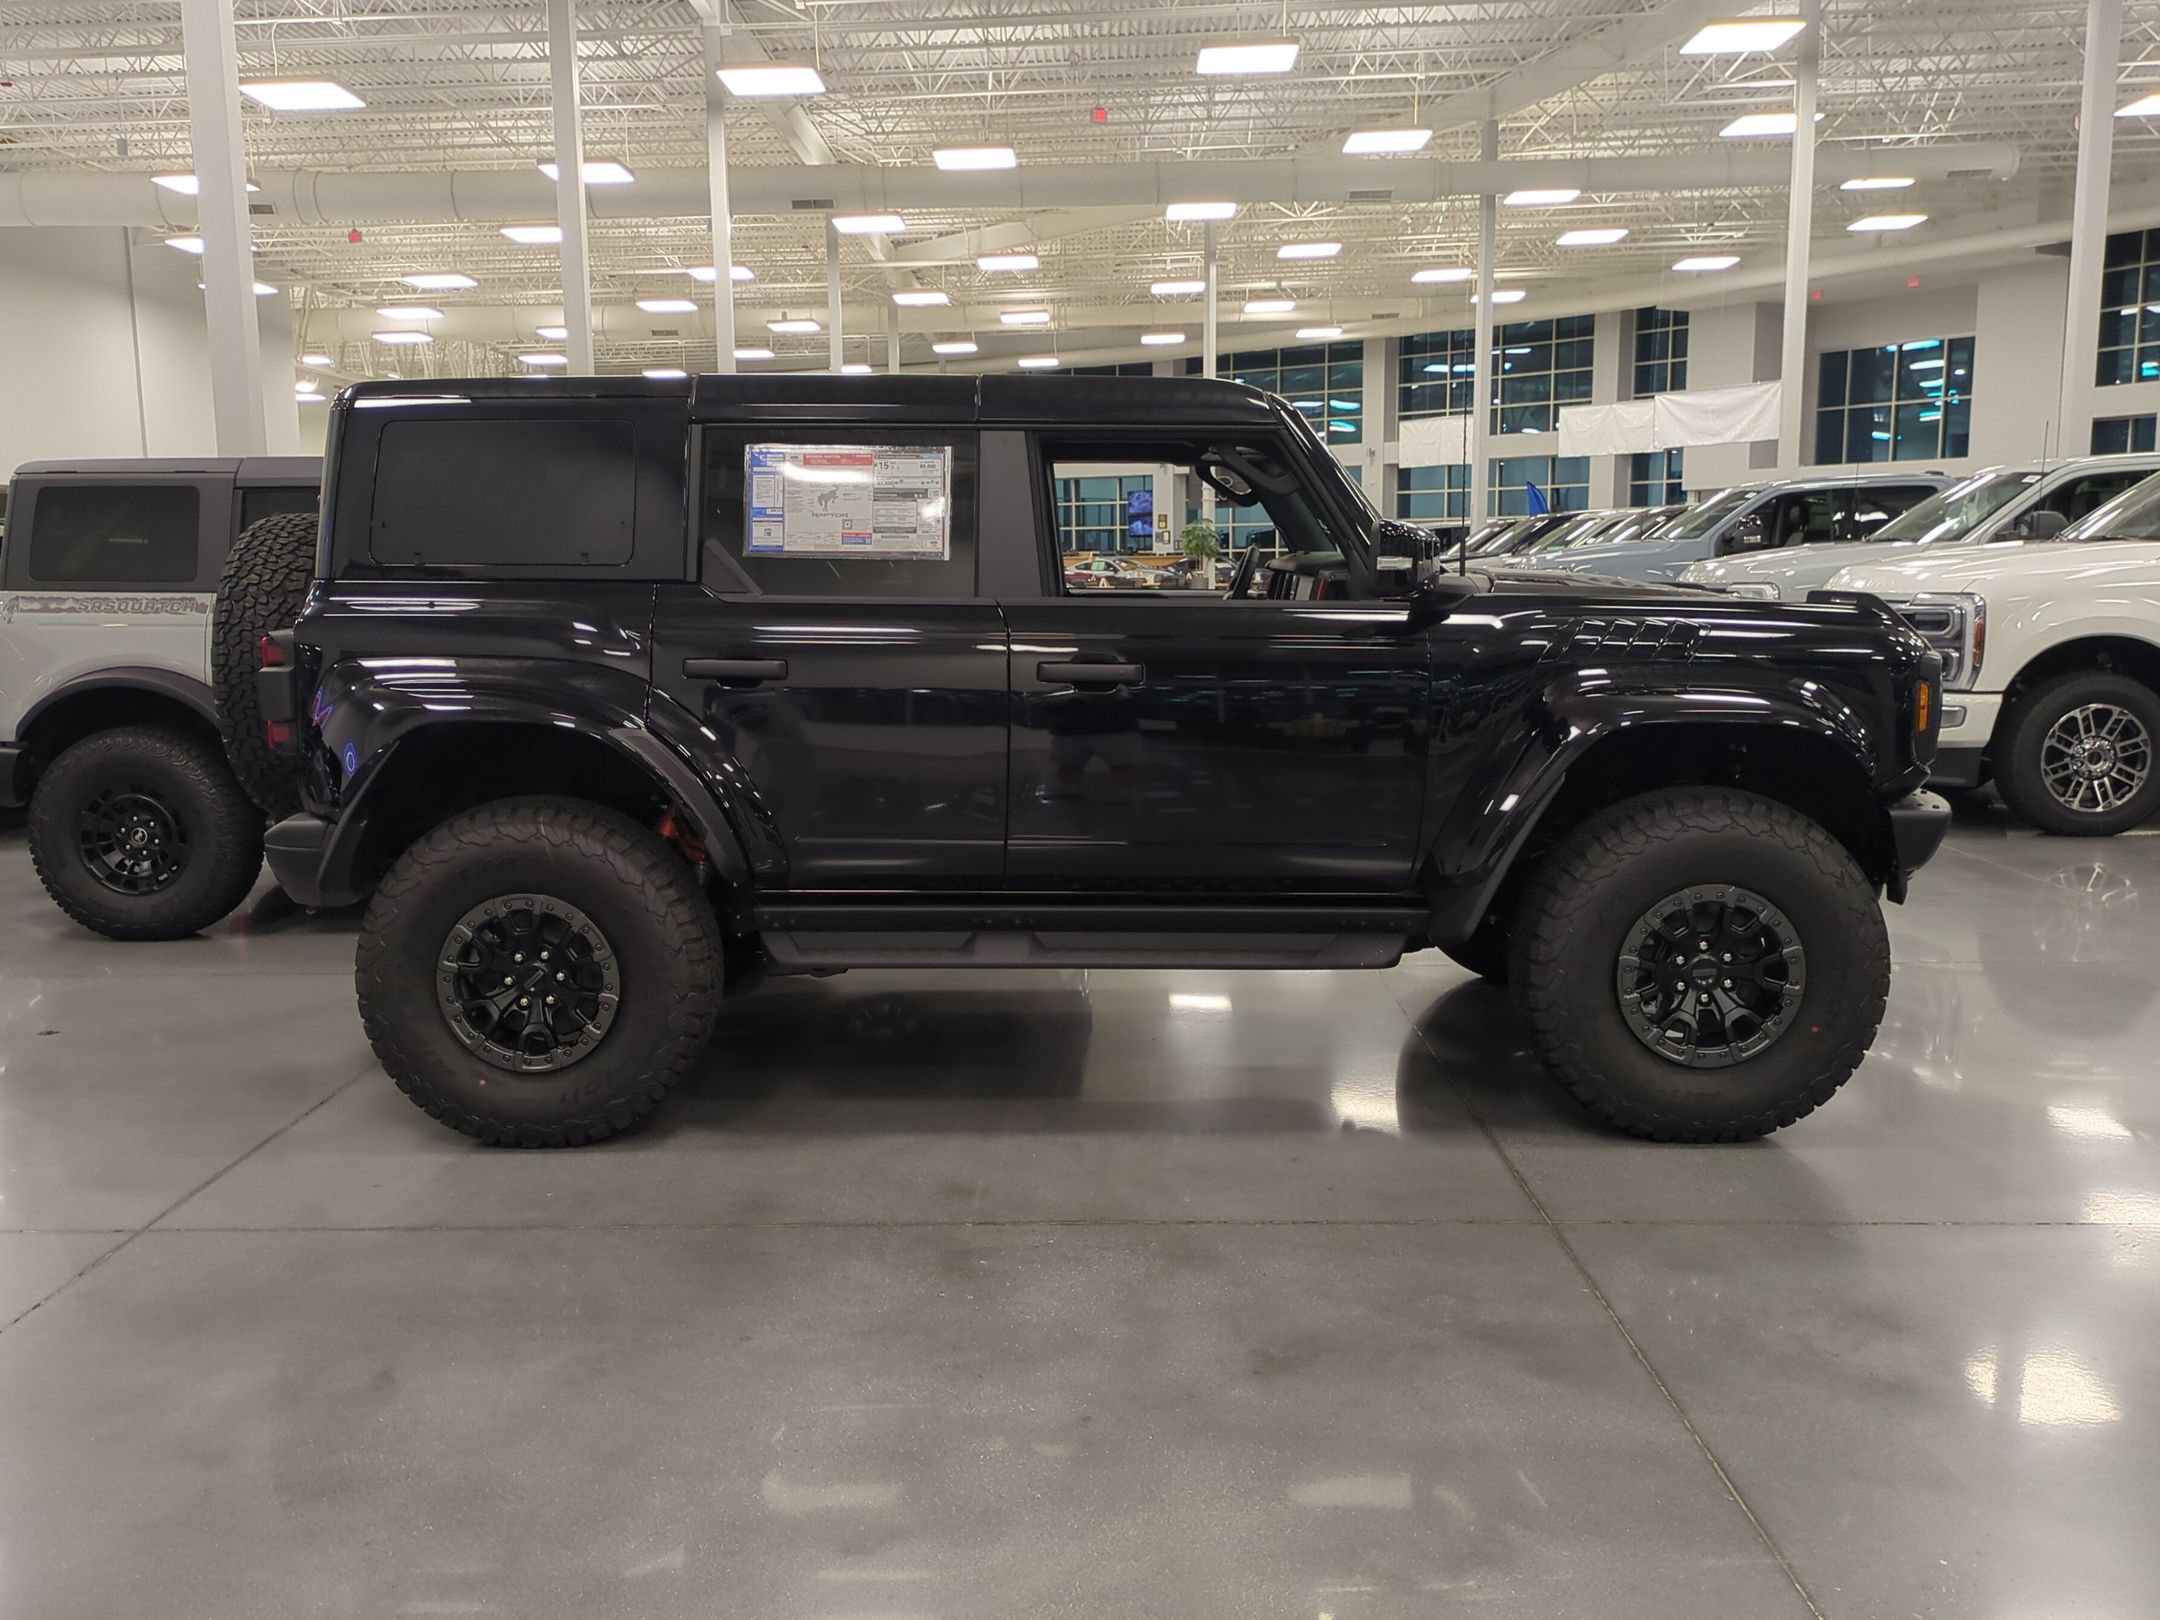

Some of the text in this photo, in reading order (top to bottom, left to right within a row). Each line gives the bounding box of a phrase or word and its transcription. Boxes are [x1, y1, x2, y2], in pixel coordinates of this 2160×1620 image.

[879, 462, 889, 470] 15
[810, 511, 849, 519] RAPTOR
[78, 600, 195, 612] SASQUATCH
